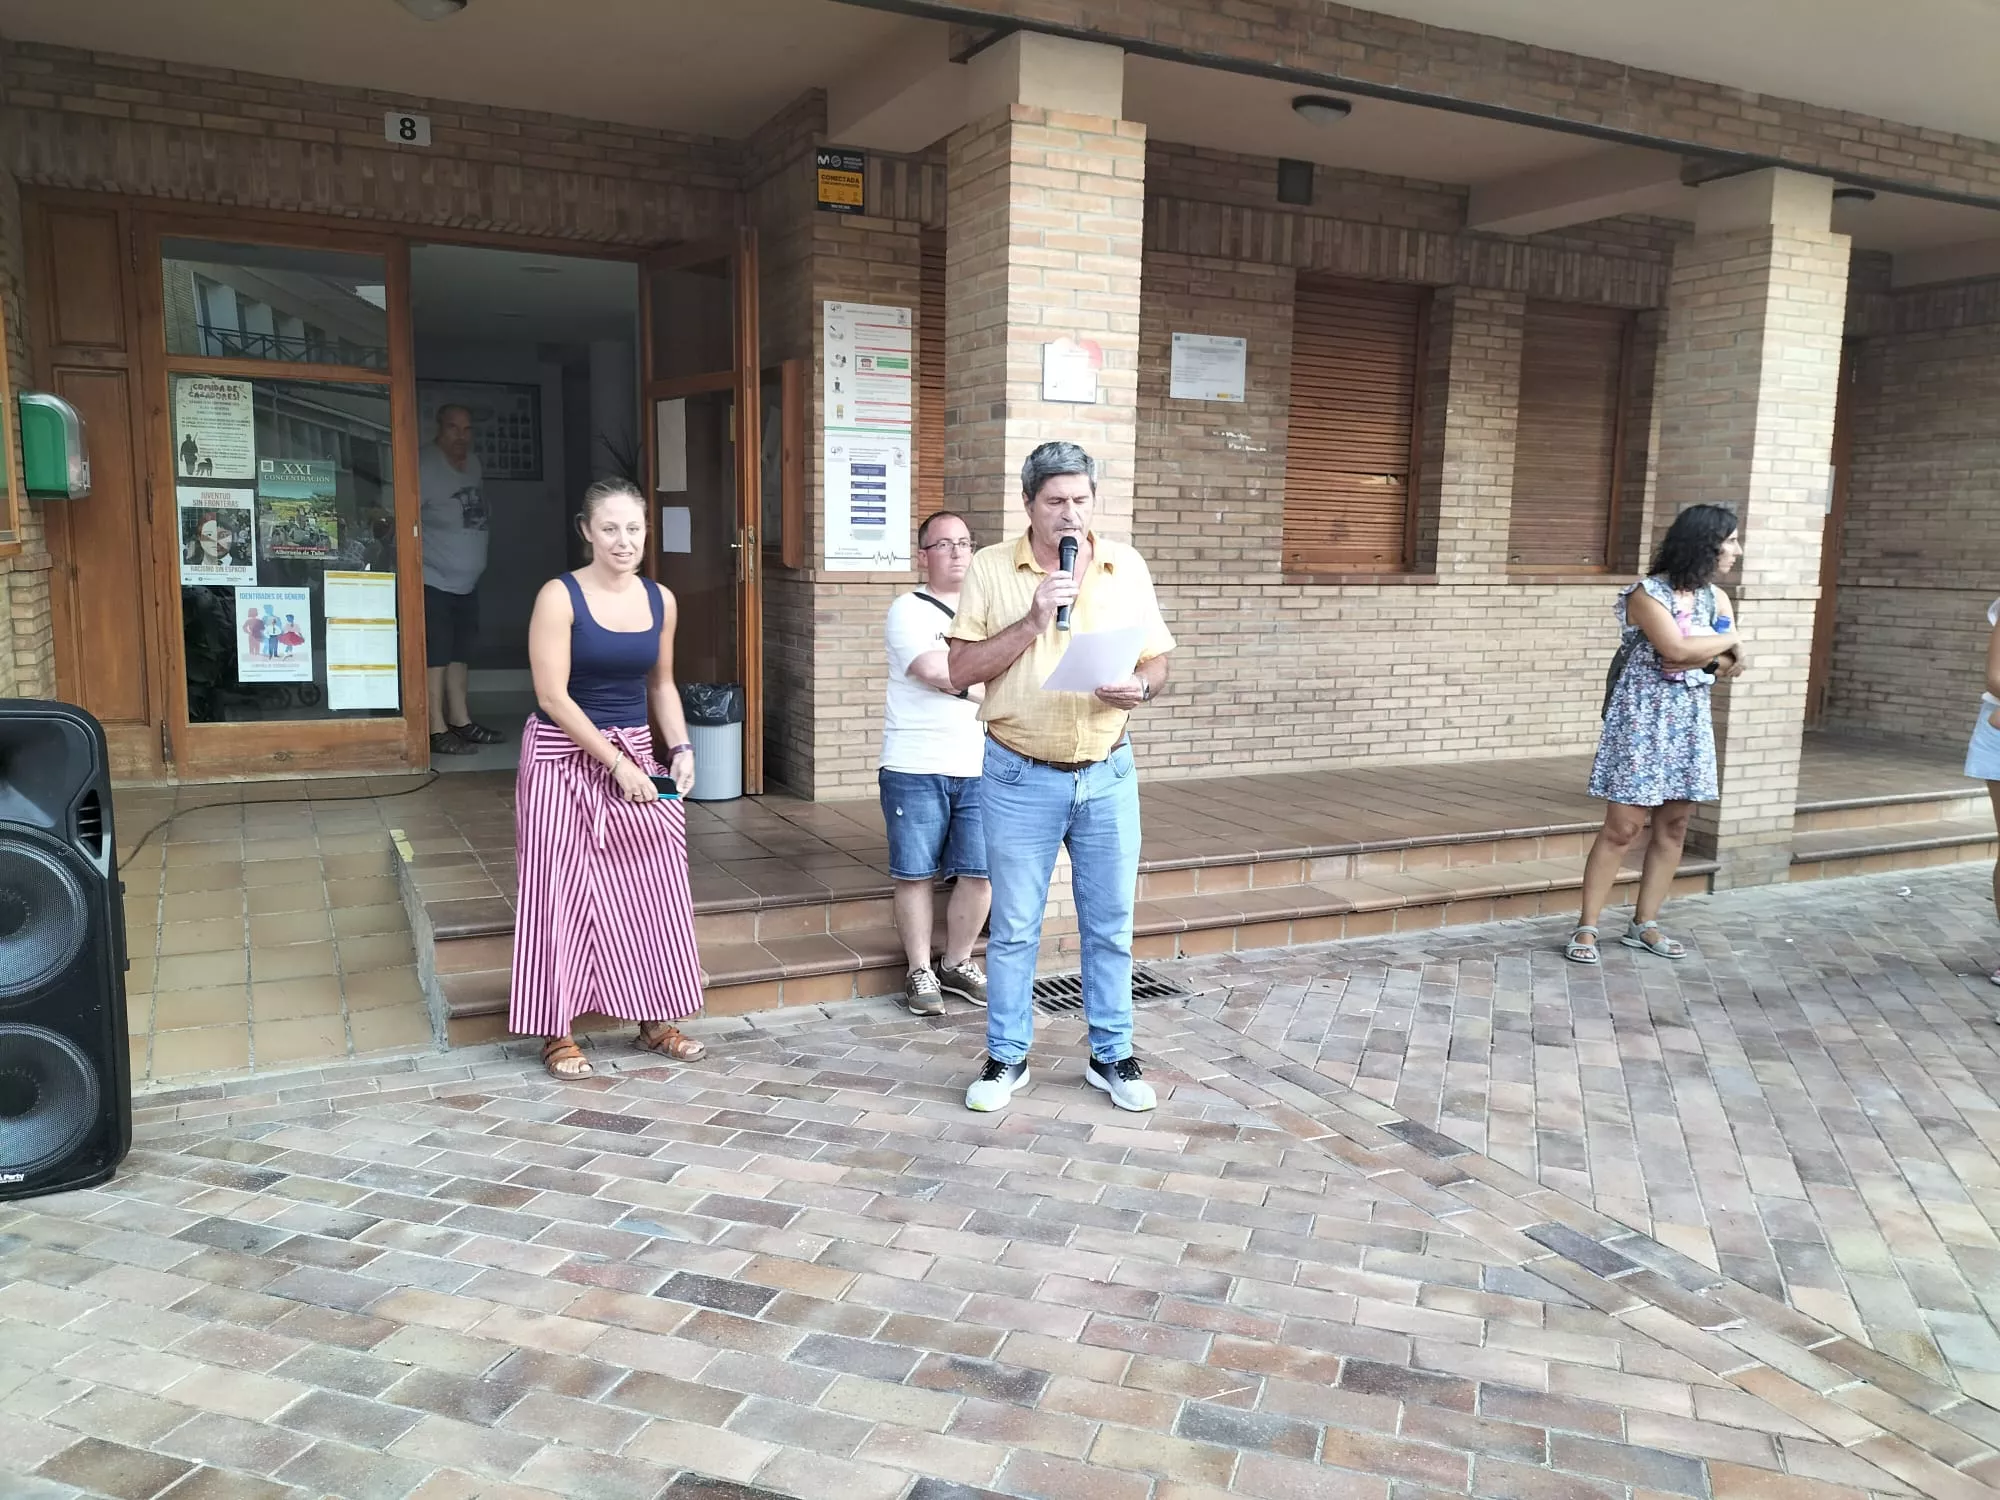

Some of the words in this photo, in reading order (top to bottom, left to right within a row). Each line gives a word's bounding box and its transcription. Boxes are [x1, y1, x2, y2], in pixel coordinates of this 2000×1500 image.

[400, 117, 416, 140] 8
[821, 174, 859, 184] CONECTADA
[282, 463, 312, 475] XXI
[201, 492, 230, 500] JUVENTUD
[240, 592, 275, 600] IDENTIDADES
